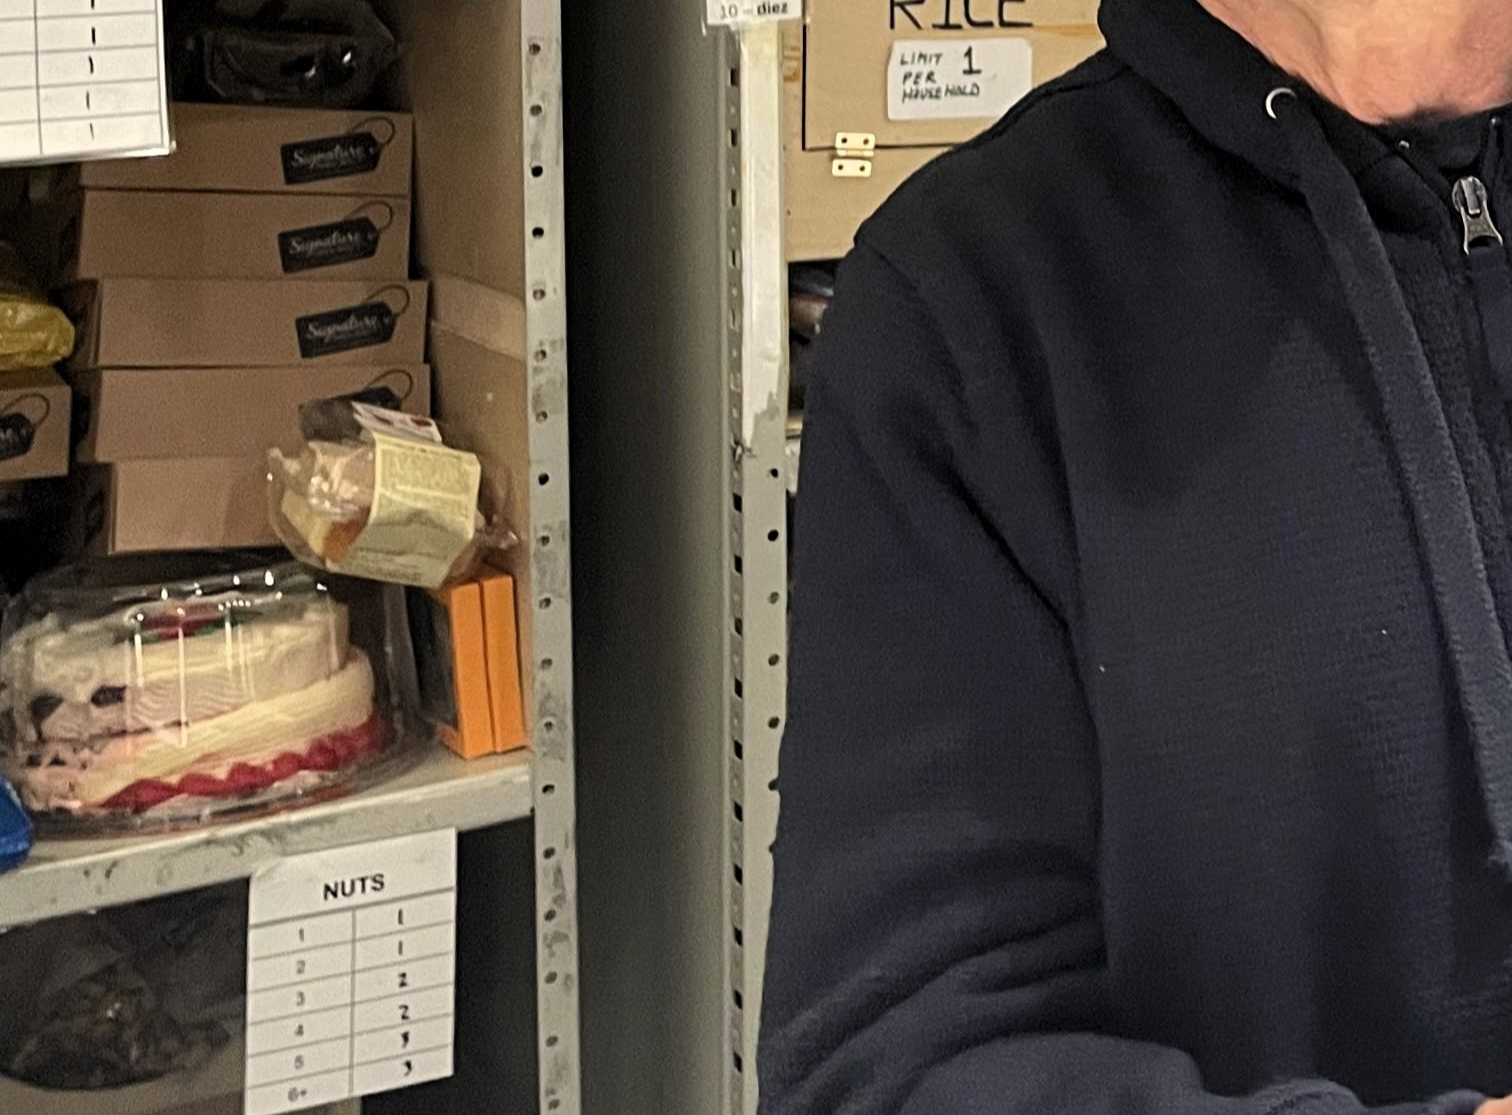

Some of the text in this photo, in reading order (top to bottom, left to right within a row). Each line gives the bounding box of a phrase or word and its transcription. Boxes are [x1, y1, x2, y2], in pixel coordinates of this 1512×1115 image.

[720, 4, 738, 20] 10
[757, 1, 788, 16] diez
[900, 45, 983, 75] LIMIT 1
[902, 70, 937, 85] PER
[322, 873, 386, 902] NUTS
[399, 1004, 410, 1021] 2
